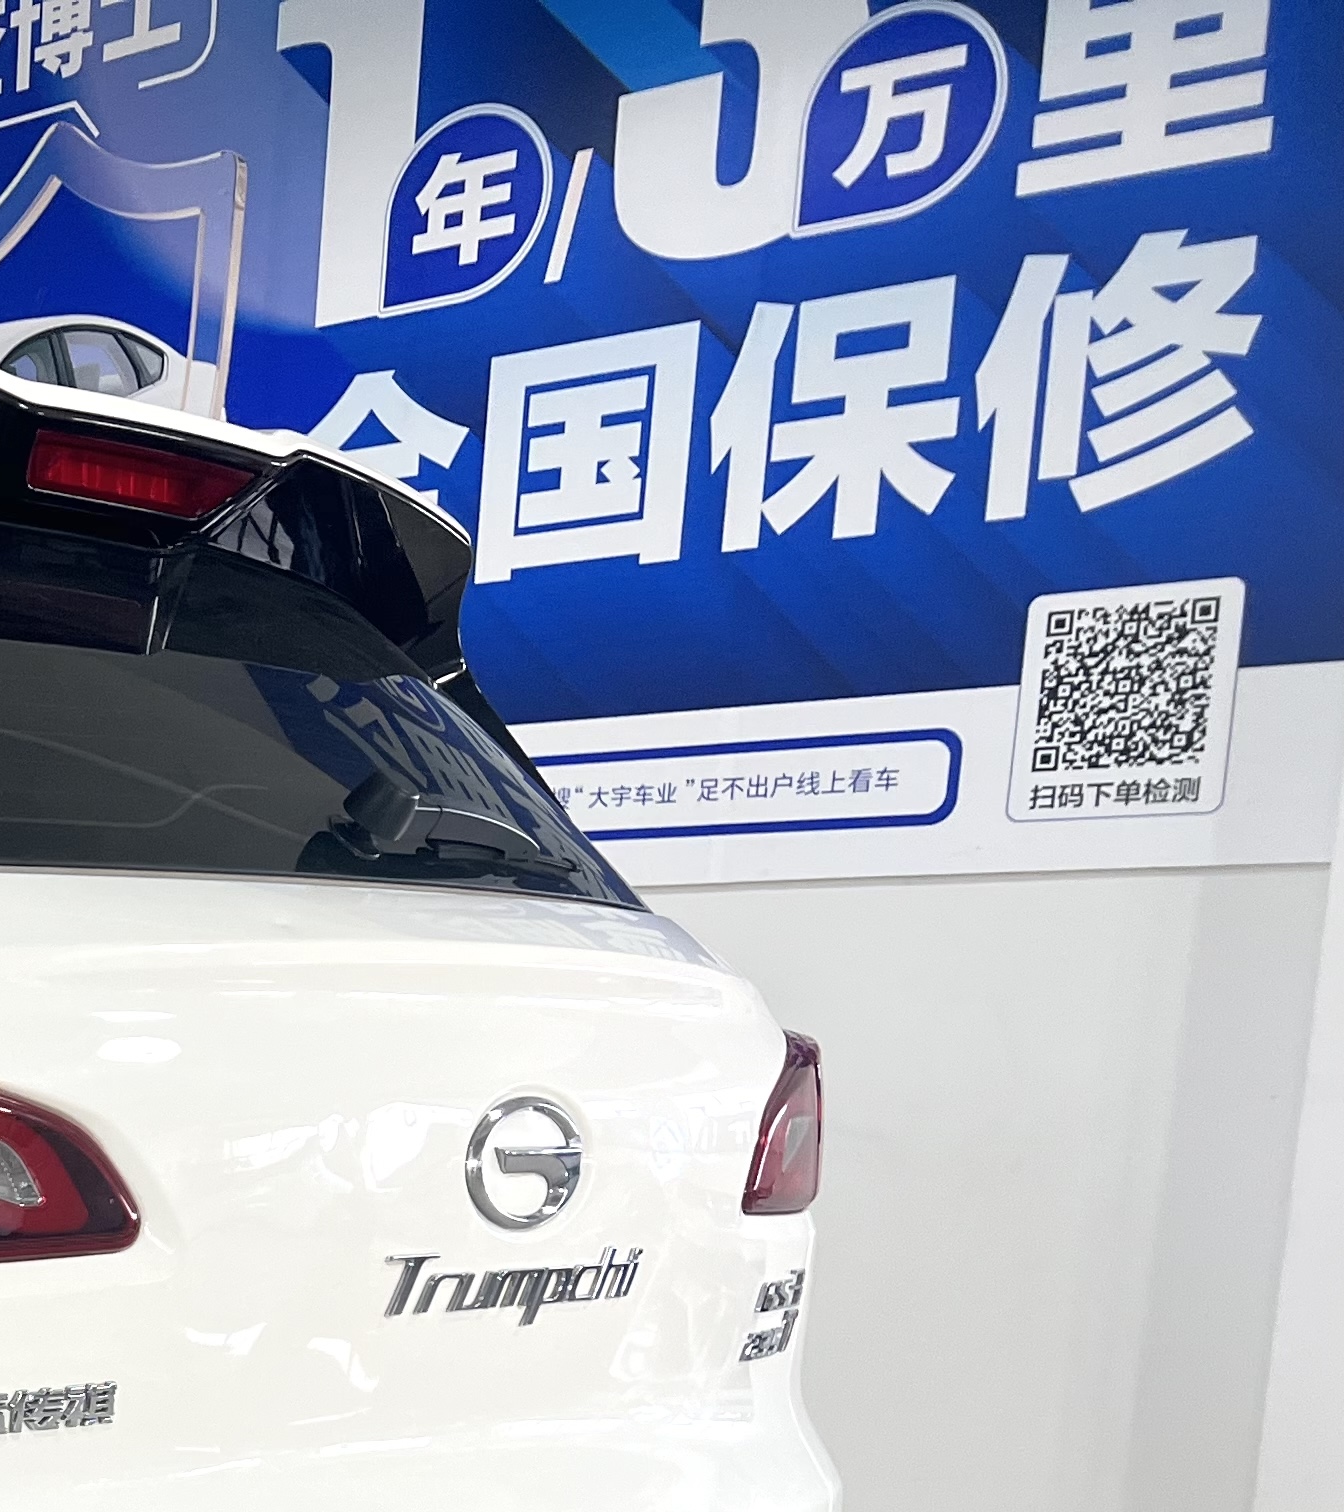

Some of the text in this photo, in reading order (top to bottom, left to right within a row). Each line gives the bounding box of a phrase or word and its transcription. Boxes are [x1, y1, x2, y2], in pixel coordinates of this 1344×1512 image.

[1028, 776, 1202, 810] 扫码下单检测
[383, 1245, 644, 1327] Trumpchi
